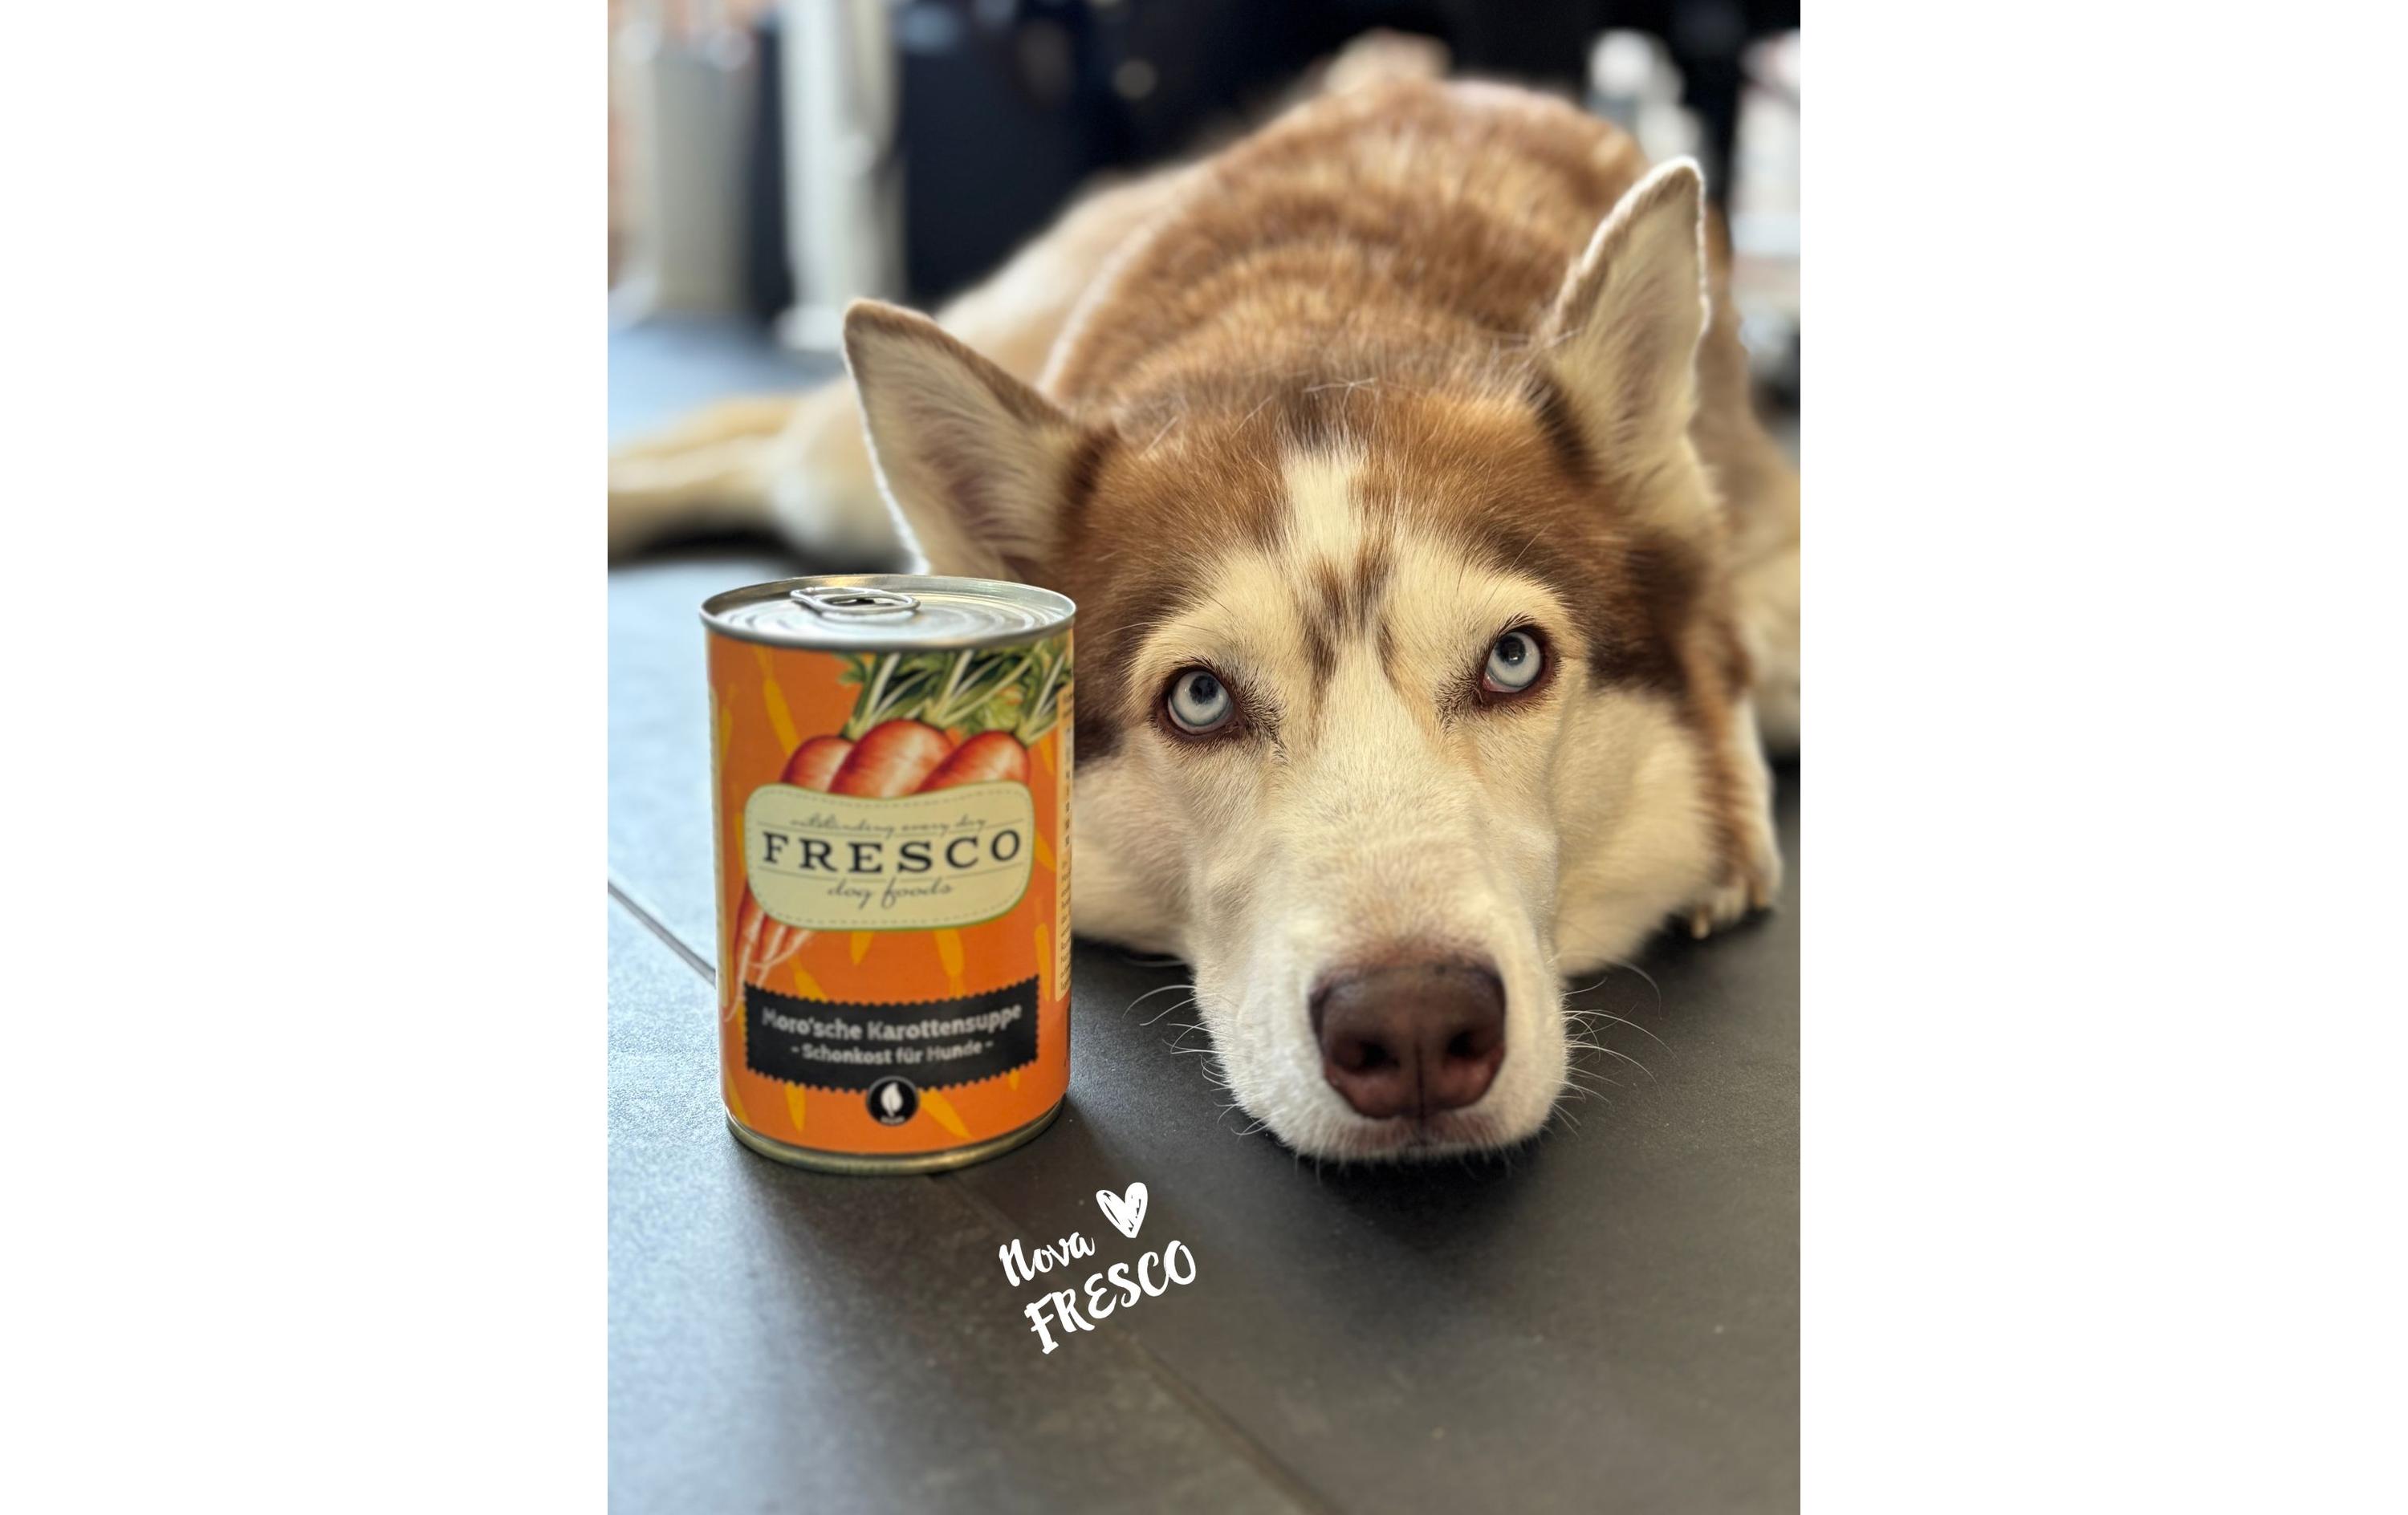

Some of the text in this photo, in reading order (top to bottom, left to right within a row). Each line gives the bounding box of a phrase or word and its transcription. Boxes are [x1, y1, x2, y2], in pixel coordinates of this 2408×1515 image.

[762, 830, 1021, 873] FRESCO
[828, 876, 953, 909] dog foods
[762, 1005, 1023, 1041] Moro'sche Karottensuppe
[802, 1043, 893, 1065] Schonkost
[895, 1046, 922, 1064] für
[926, 1039, 982, 1062] Hunde
